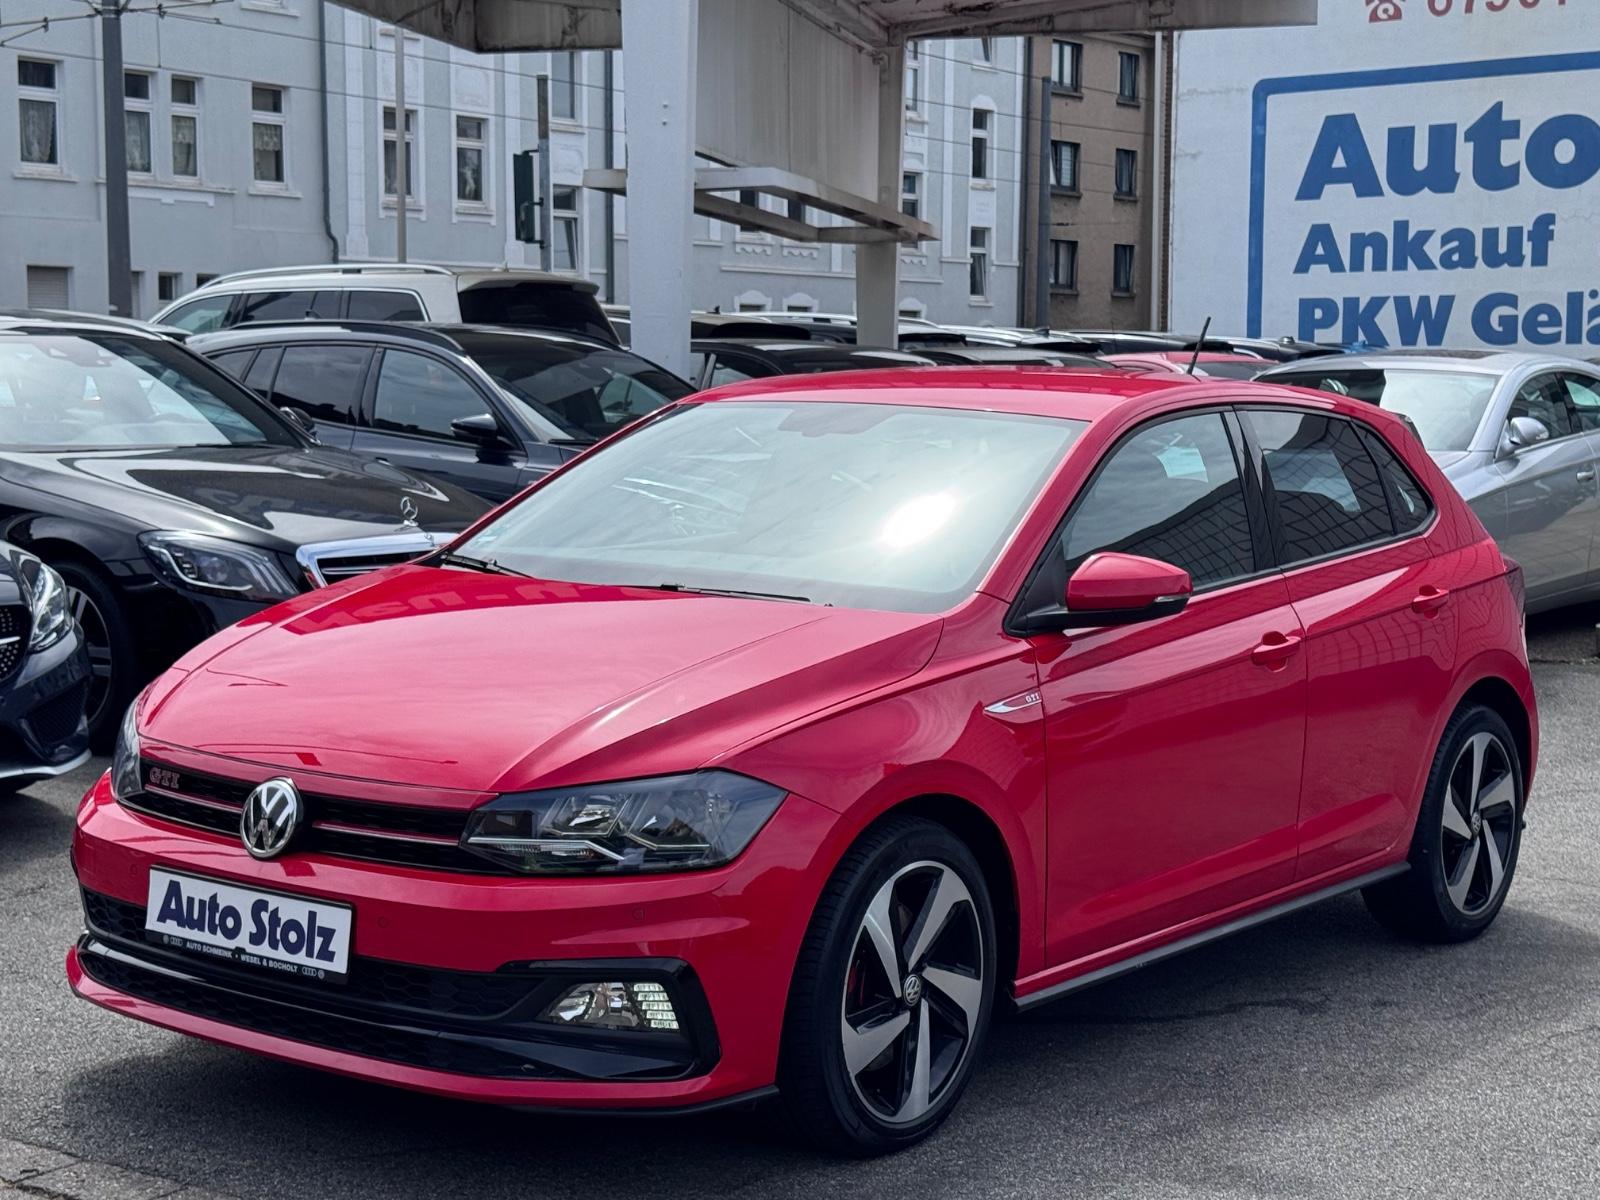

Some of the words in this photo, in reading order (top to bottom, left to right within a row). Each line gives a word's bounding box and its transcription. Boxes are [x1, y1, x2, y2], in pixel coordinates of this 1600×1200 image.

[1295, 101, 1600, 201] Auto
[1293, 213, 1556, 274] Ankauf
[1298, 295, 1456, 347] PKW
[1025, 692, 1040, 703] GTI
[149, 766, 180, 790] GTI
[156, 879, 242, 941] Auto
[249, 898, 337, 963] Stolz
[186, 940, 202, 951] AUTO
[240, 953, 262, 965] WESEL
[268, 959, 299, 973] BOCHOLT
